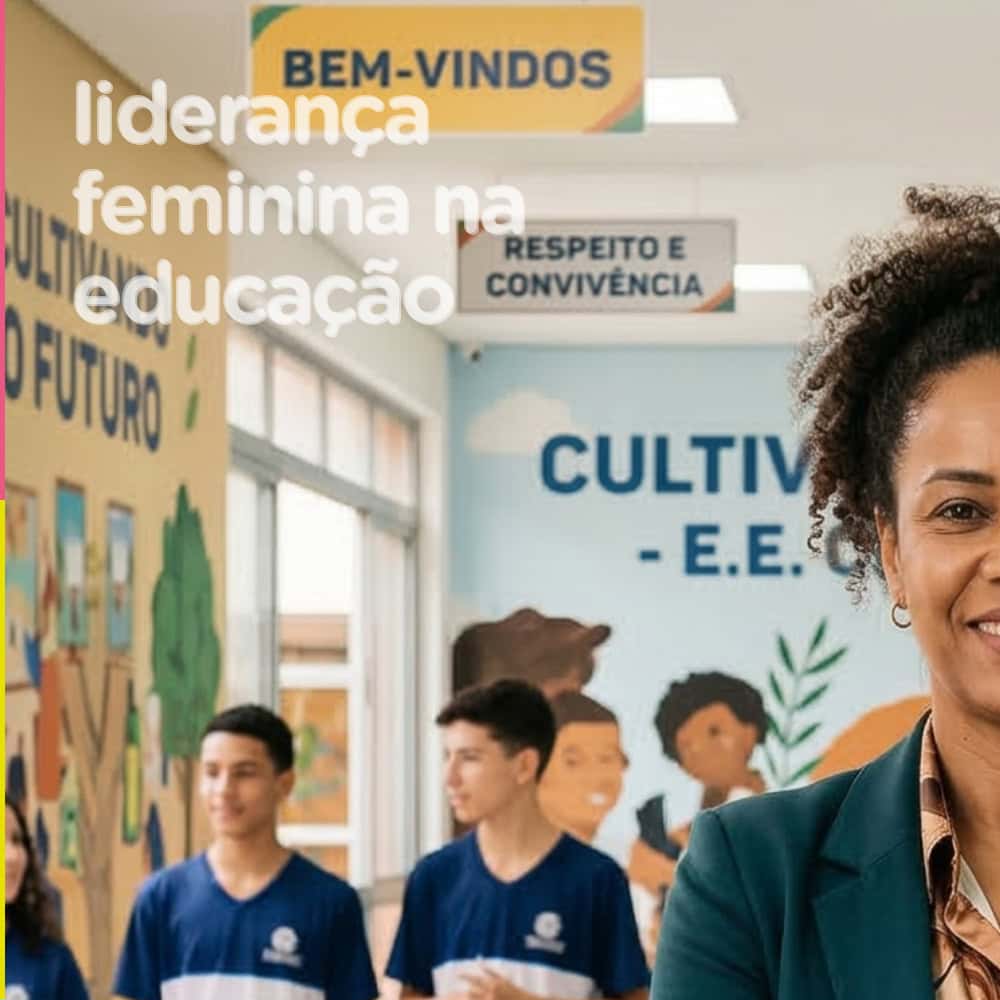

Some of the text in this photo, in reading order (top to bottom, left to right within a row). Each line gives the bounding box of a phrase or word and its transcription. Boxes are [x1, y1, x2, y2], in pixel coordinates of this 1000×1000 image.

[283, 49, 611, 89] BEM-VINDOS
[504, 235, 686, 261] RESPEITO E
[485, 267, 702, 298] CONVIVÊNCIA
[34, 319, 162, 454] FUTURO
[684, 524, 804, 577] E.E.
